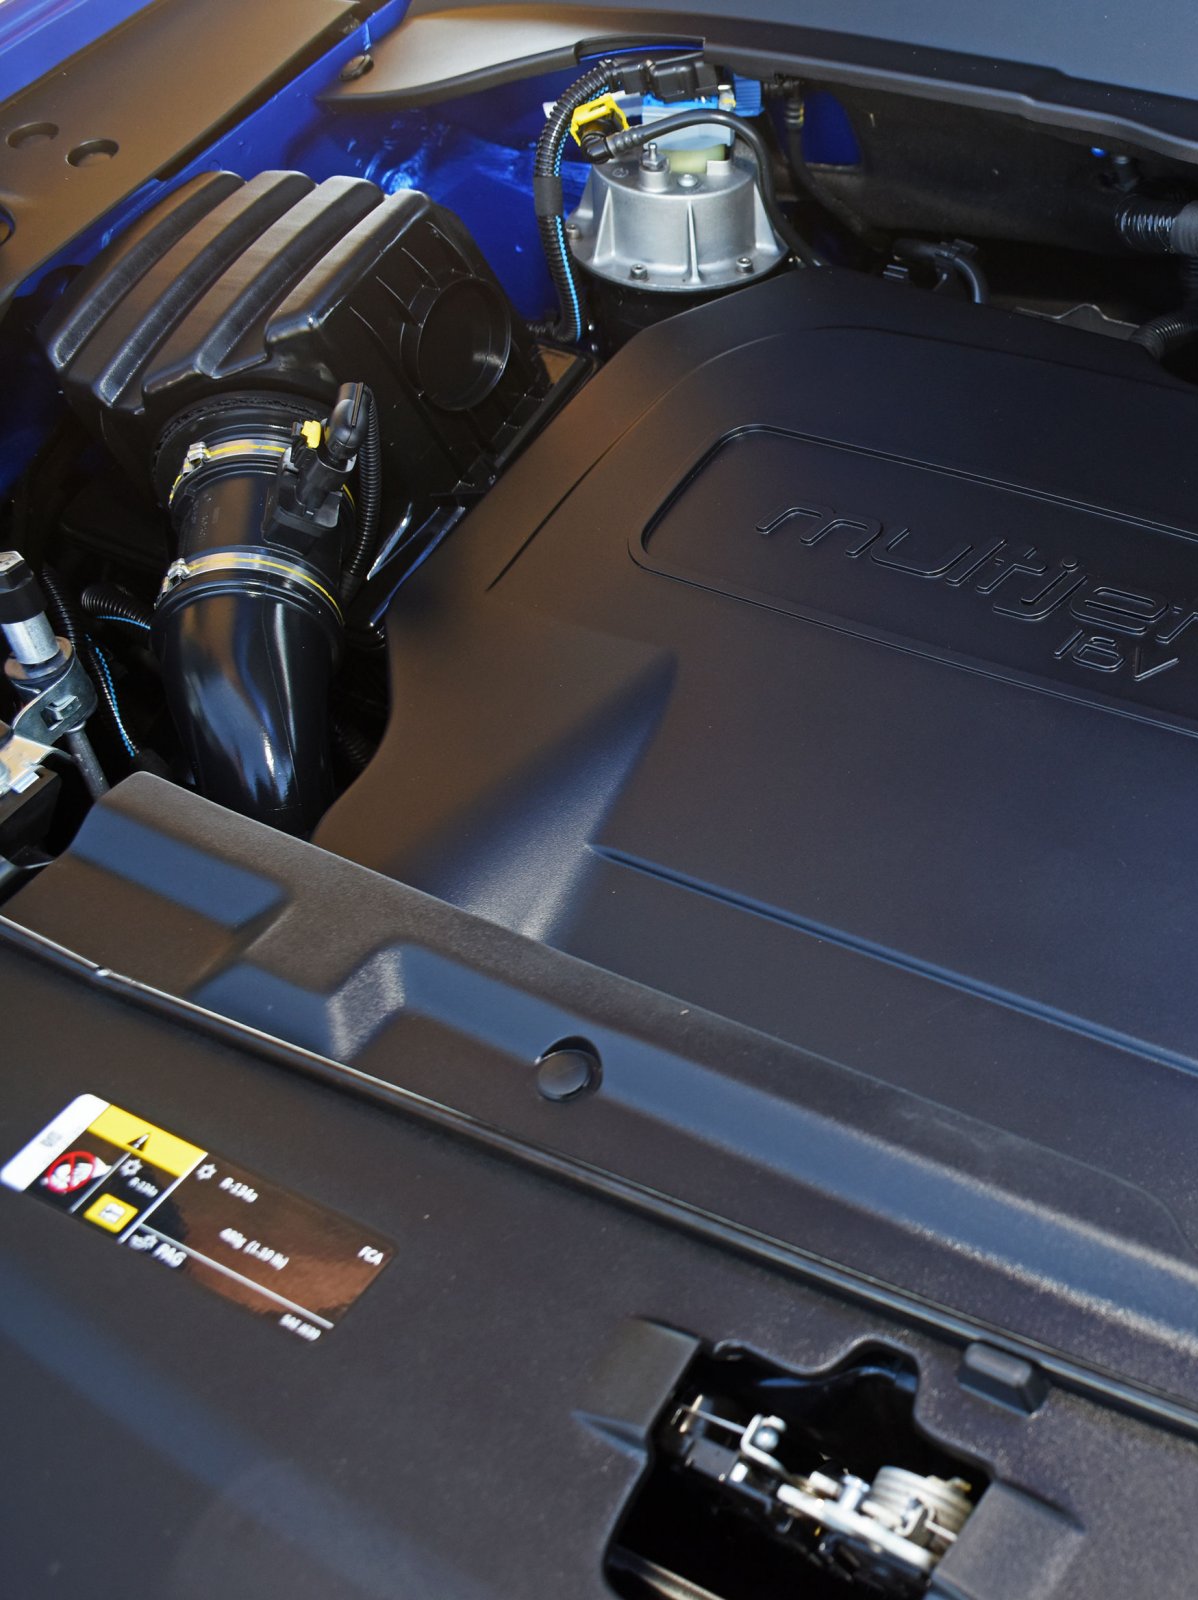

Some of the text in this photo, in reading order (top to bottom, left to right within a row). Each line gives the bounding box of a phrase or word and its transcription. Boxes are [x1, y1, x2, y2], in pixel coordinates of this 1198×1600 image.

[1053, 629, 1179, 681] 16V
[152, 1242, 187, 1268] PAG
[357, 1245, 384, 1266] FCA
